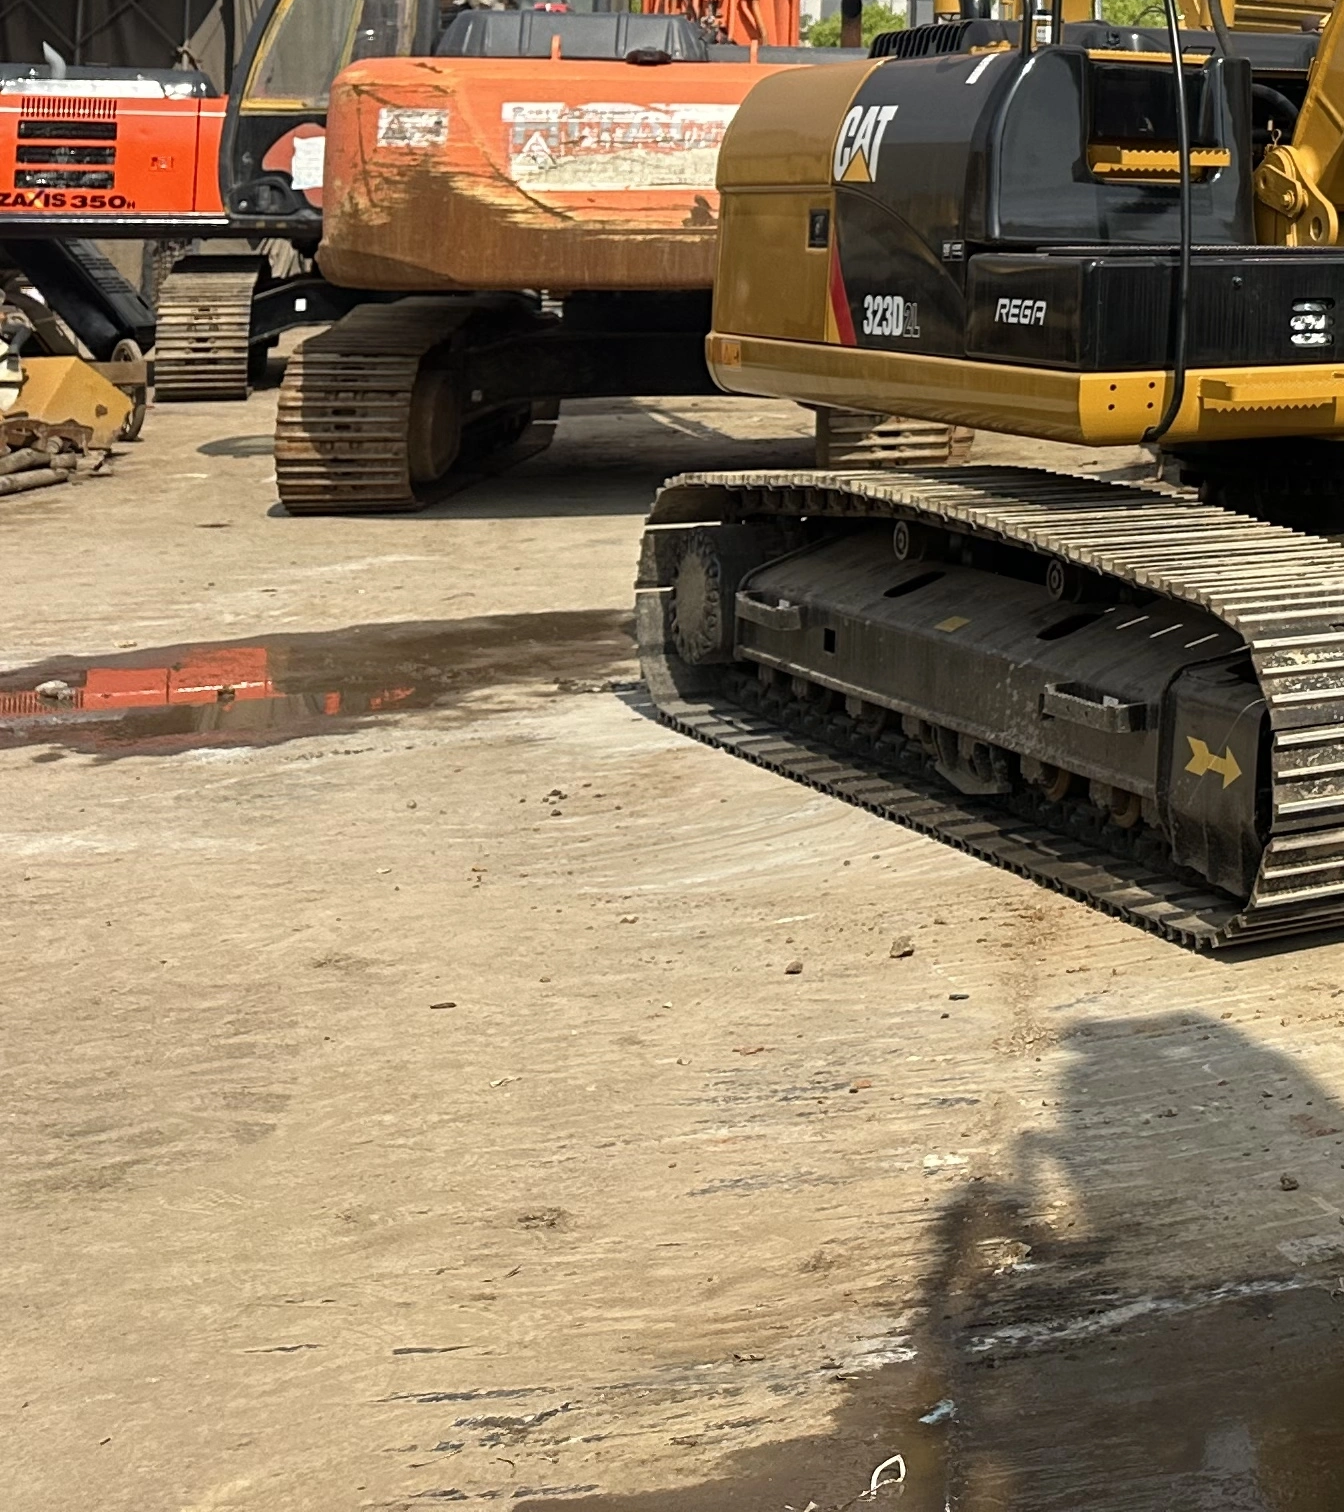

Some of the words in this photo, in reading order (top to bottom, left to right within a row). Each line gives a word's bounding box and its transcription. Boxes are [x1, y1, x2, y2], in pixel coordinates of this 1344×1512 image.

[832, 104, 900, 183] CAT
[0, 189, 67, 209] ZAXIS
[993, 297, 1048, 327] REGA
